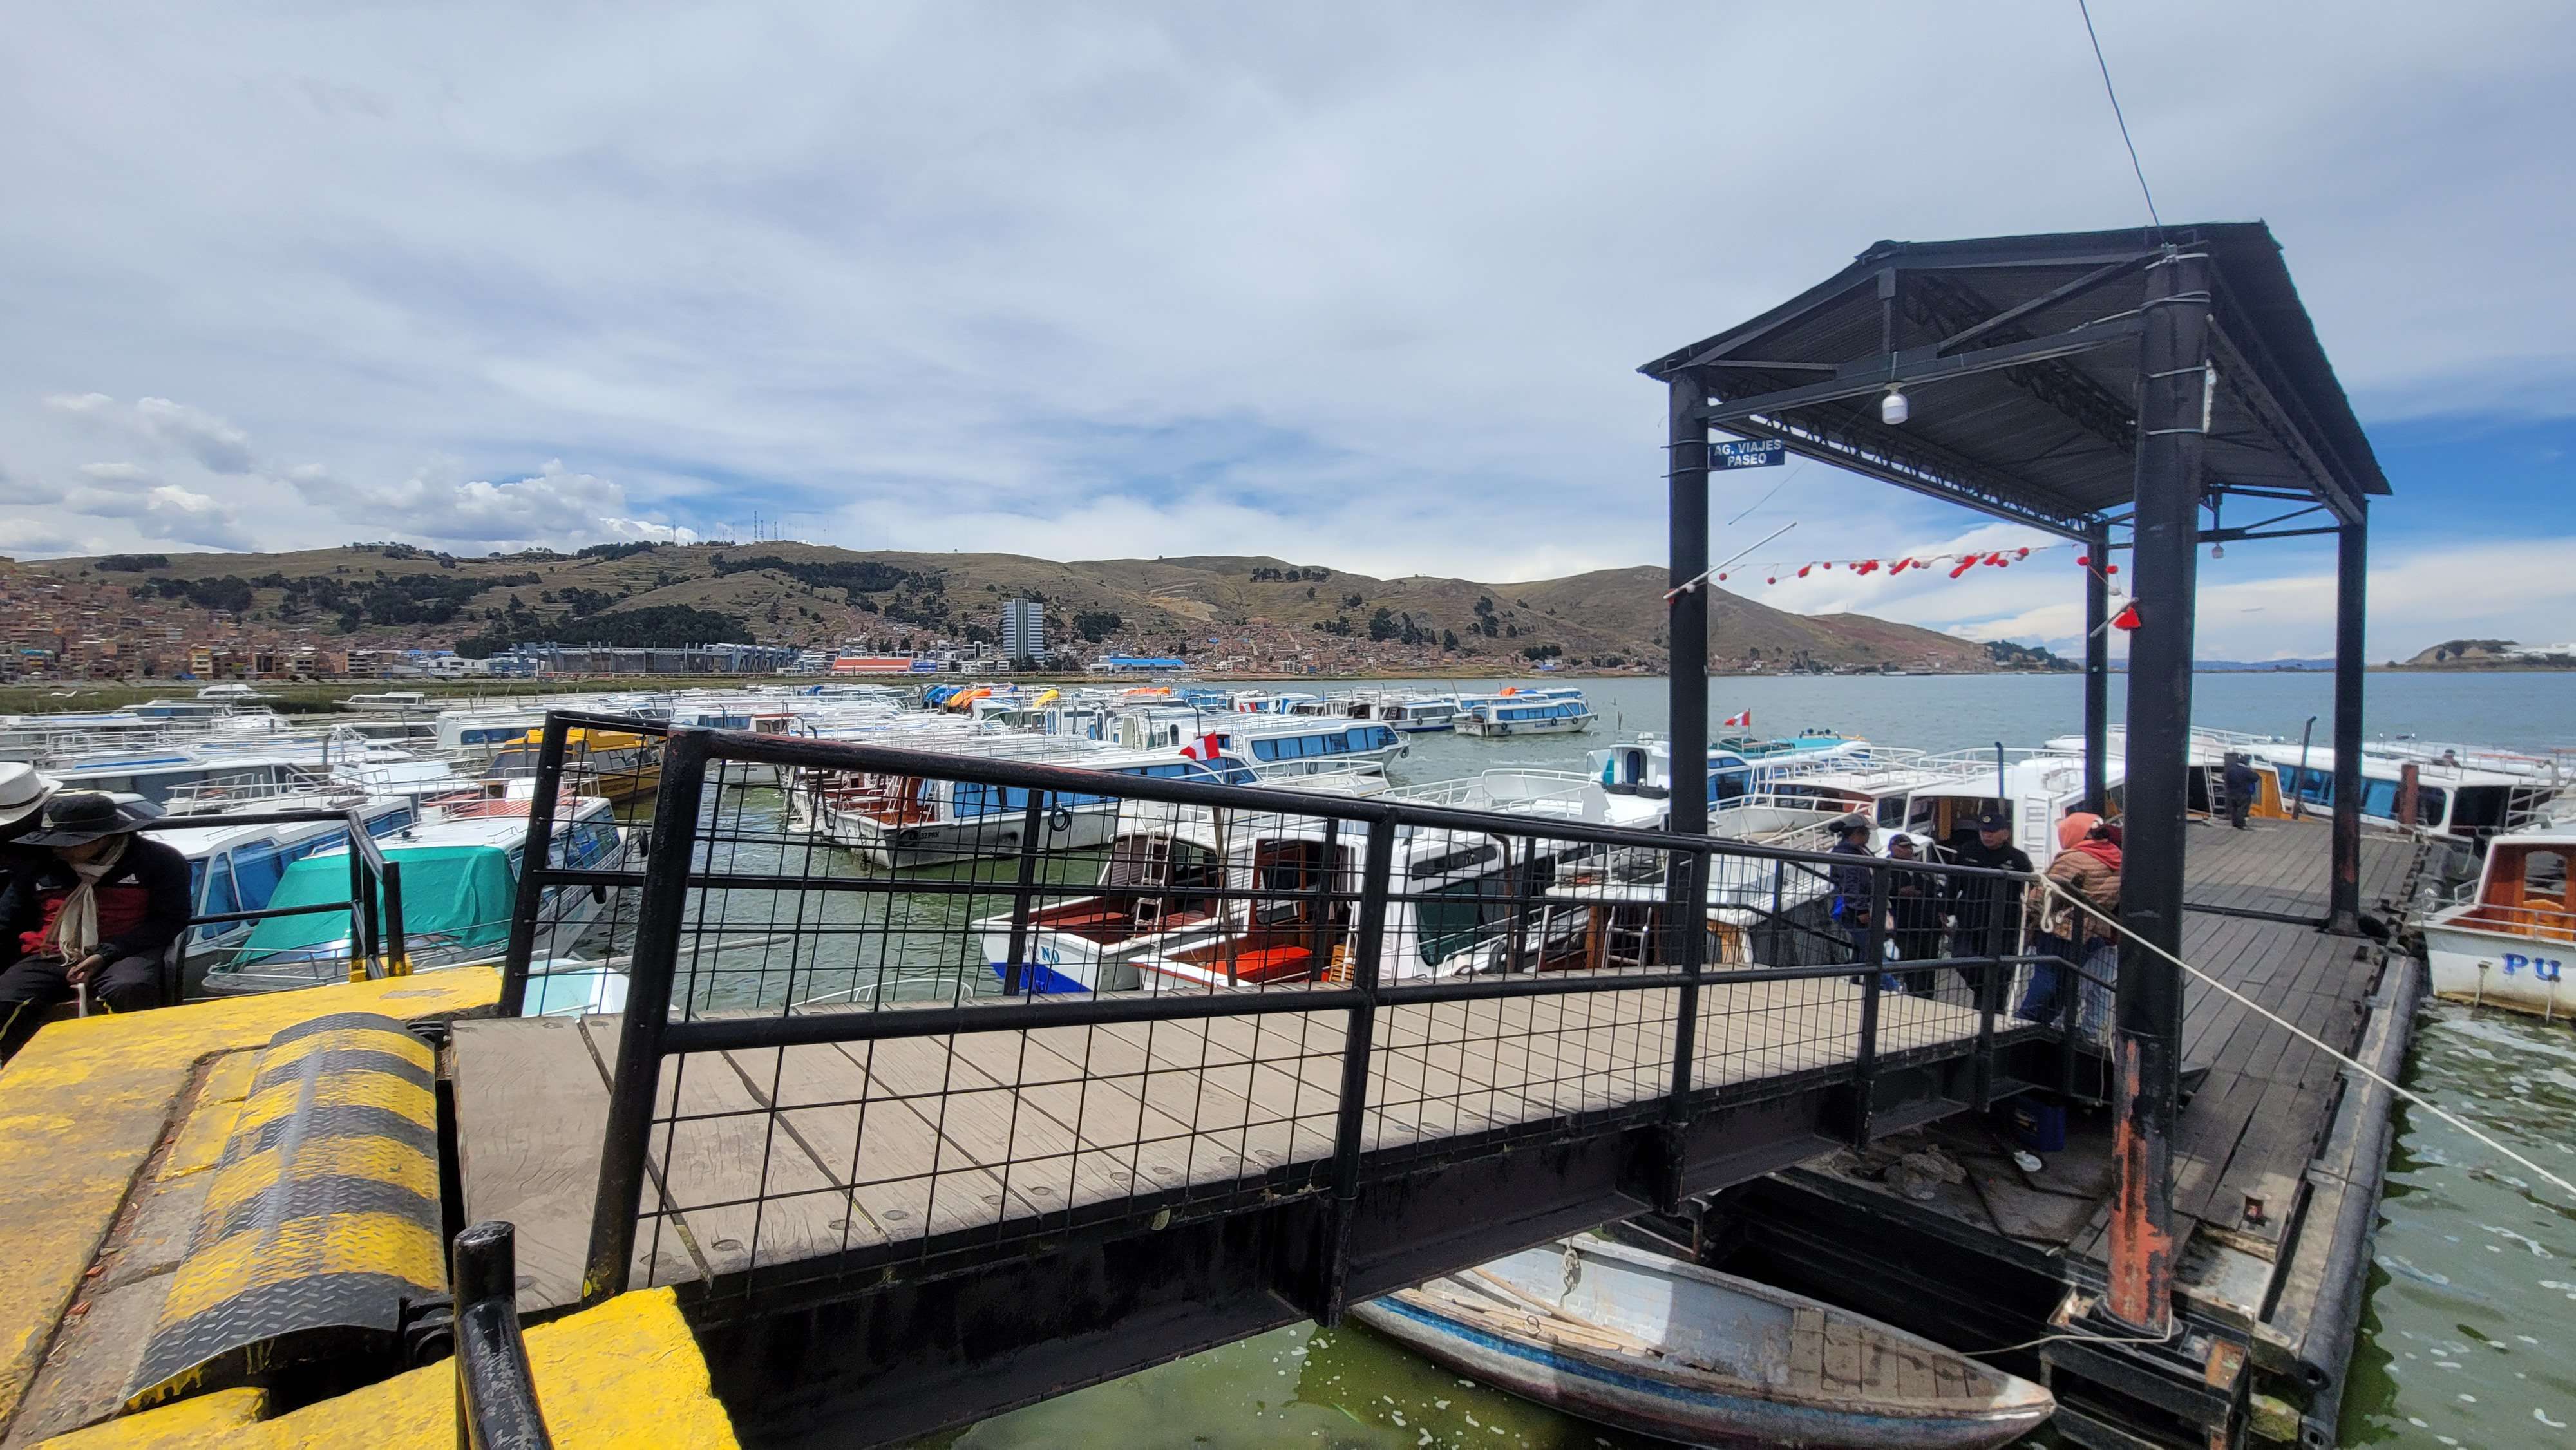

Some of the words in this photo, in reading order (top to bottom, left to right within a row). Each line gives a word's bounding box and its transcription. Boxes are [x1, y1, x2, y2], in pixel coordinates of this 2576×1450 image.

[1714, 444, 1735, 456] AG.
[1738, 439, 1782, 453] VIAJES
[1727, 453, 1767, 467] PASEO
[2501, 953, 2562, 981] PU
